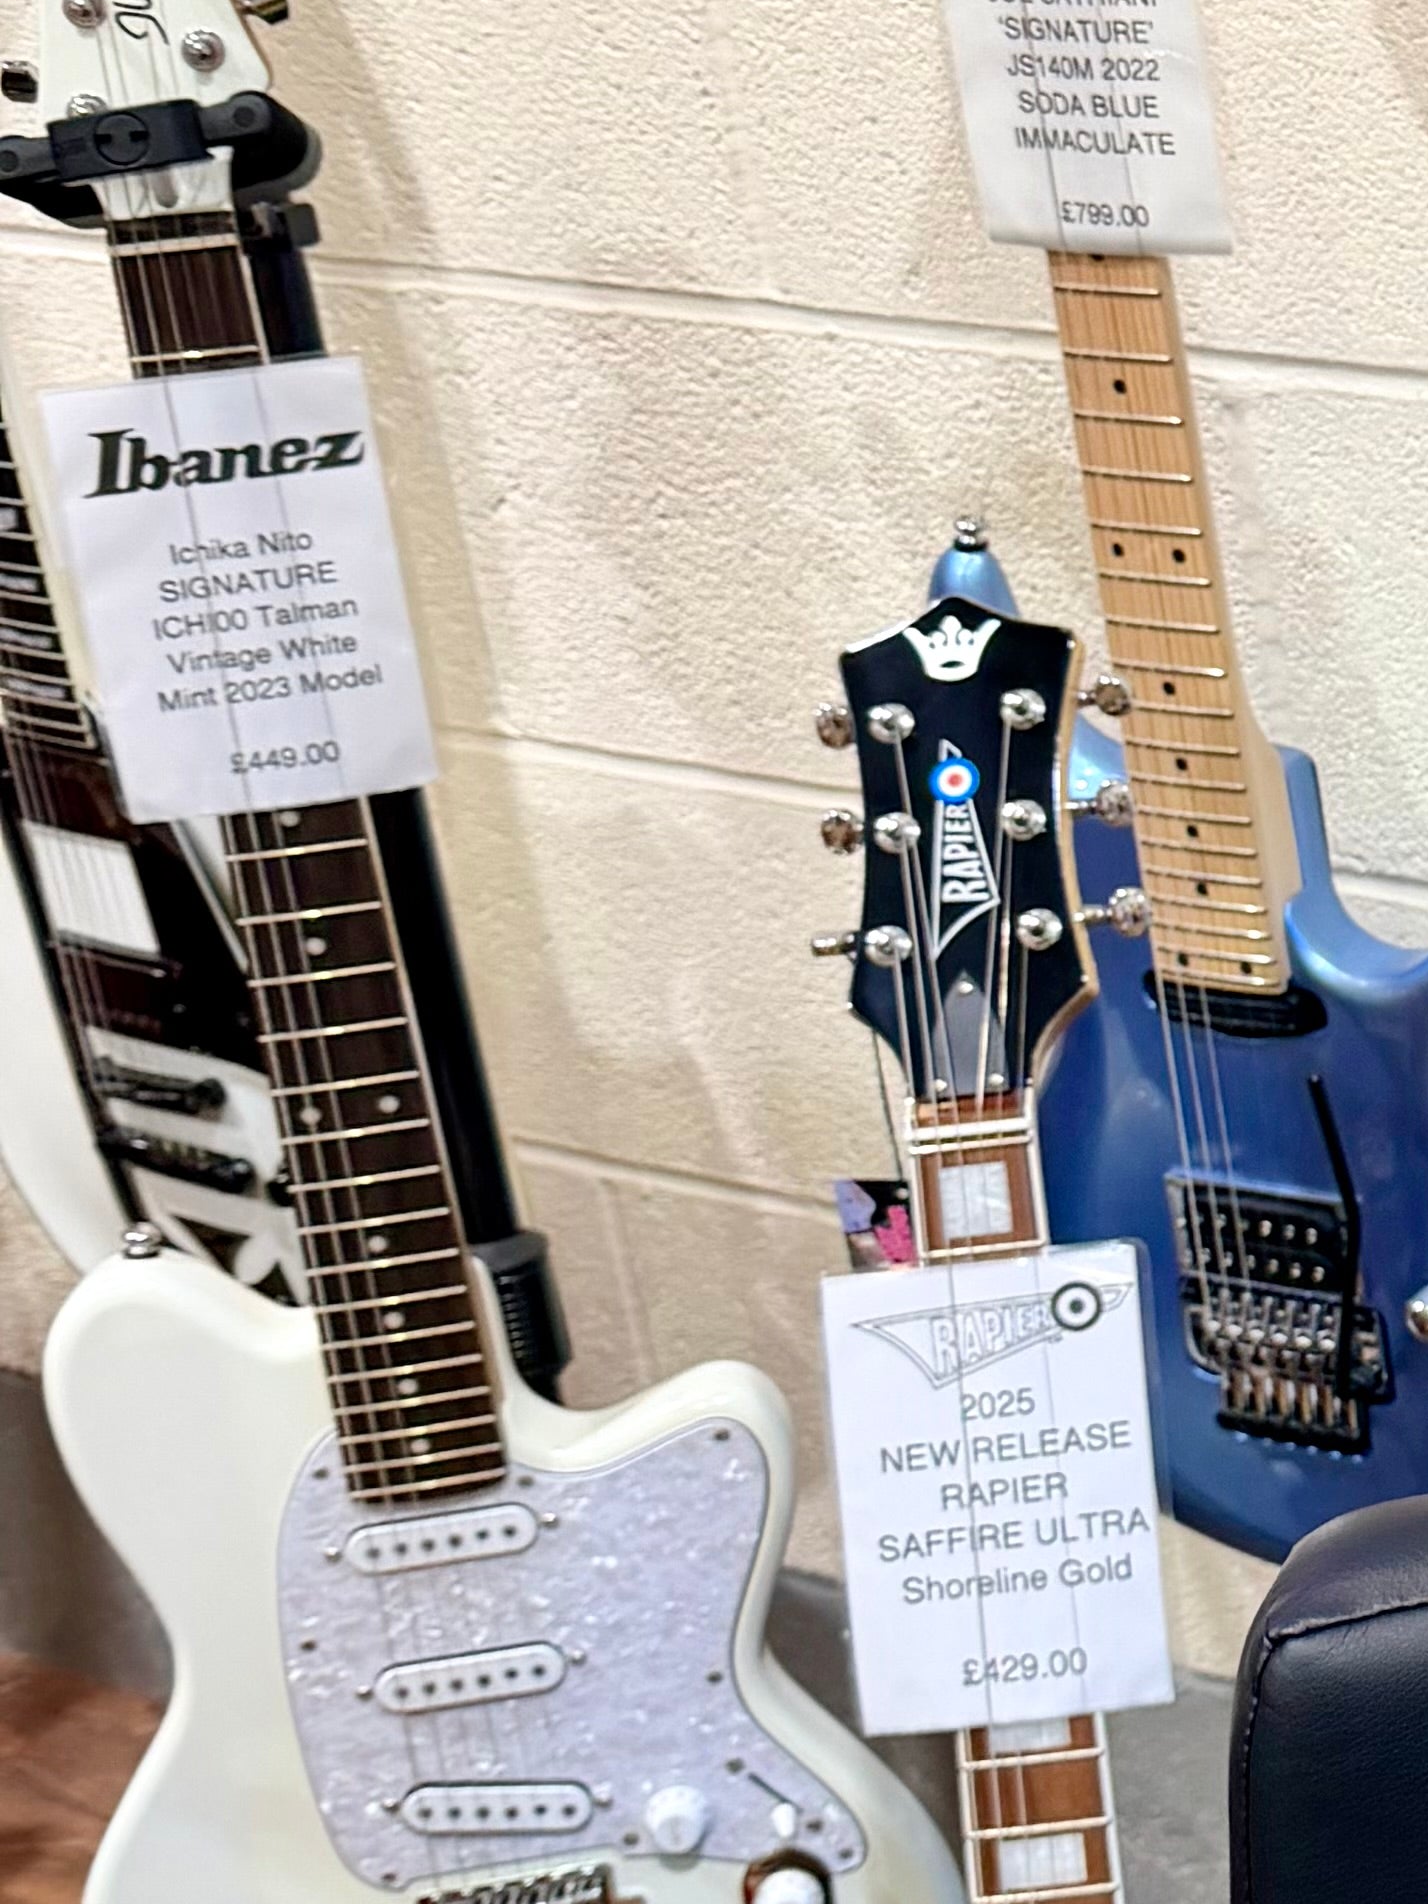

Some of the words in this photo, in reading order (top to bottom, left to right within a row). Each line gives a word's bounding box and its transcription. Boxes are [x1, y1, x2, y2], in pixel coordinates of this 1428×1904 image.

[1006, 53, 1094, 80] JS140M
[1102, 57, 1160, 81] 2022
[1018, 90, 1085, 116] SODA
[1092, 94, 1160, 118] BLUE
[1015, 126, 1176, 156] IMMACULATE
[1061, 201, 1150, 229] £799.00
[83, 428, 365, 499] Ibanez
[170, 539, 251, 565] Ichika
[258, 533, 312, 555] Nito
[160, 560, 338, 603] SIGNATURE
[254, 599, 358, 627] Talman
[167, 647, 272, 674] Vintage
[279, 635, 358, 661] White
[158, 687, 218, 712] Mint
[225, 676, 291, 703] 2023
[299, 664, 383, 694] Model
[231, 740, 341, 775] £449.00
[943, 803, 991, 903] RAPIER
[930, 1300, 1052, 1380] RAPIER
[961, 1388, 1035, 1421] 2025
[880, 1439, 961, 1474] NEW
[972, 1420, 1132, 1463] RELEASE
[940, 1472, 1069, 1511] RAPIER
[878, 1522, 1023, 1563] SAFFIRE
[1036, 1507, 1151, 1546] ULTRA
[901, 1565, 1049, 1605] Shoreline
[1060, 1553, 1133, 1587] Gold
[962, 1647, 1087, 1686] £429.00
